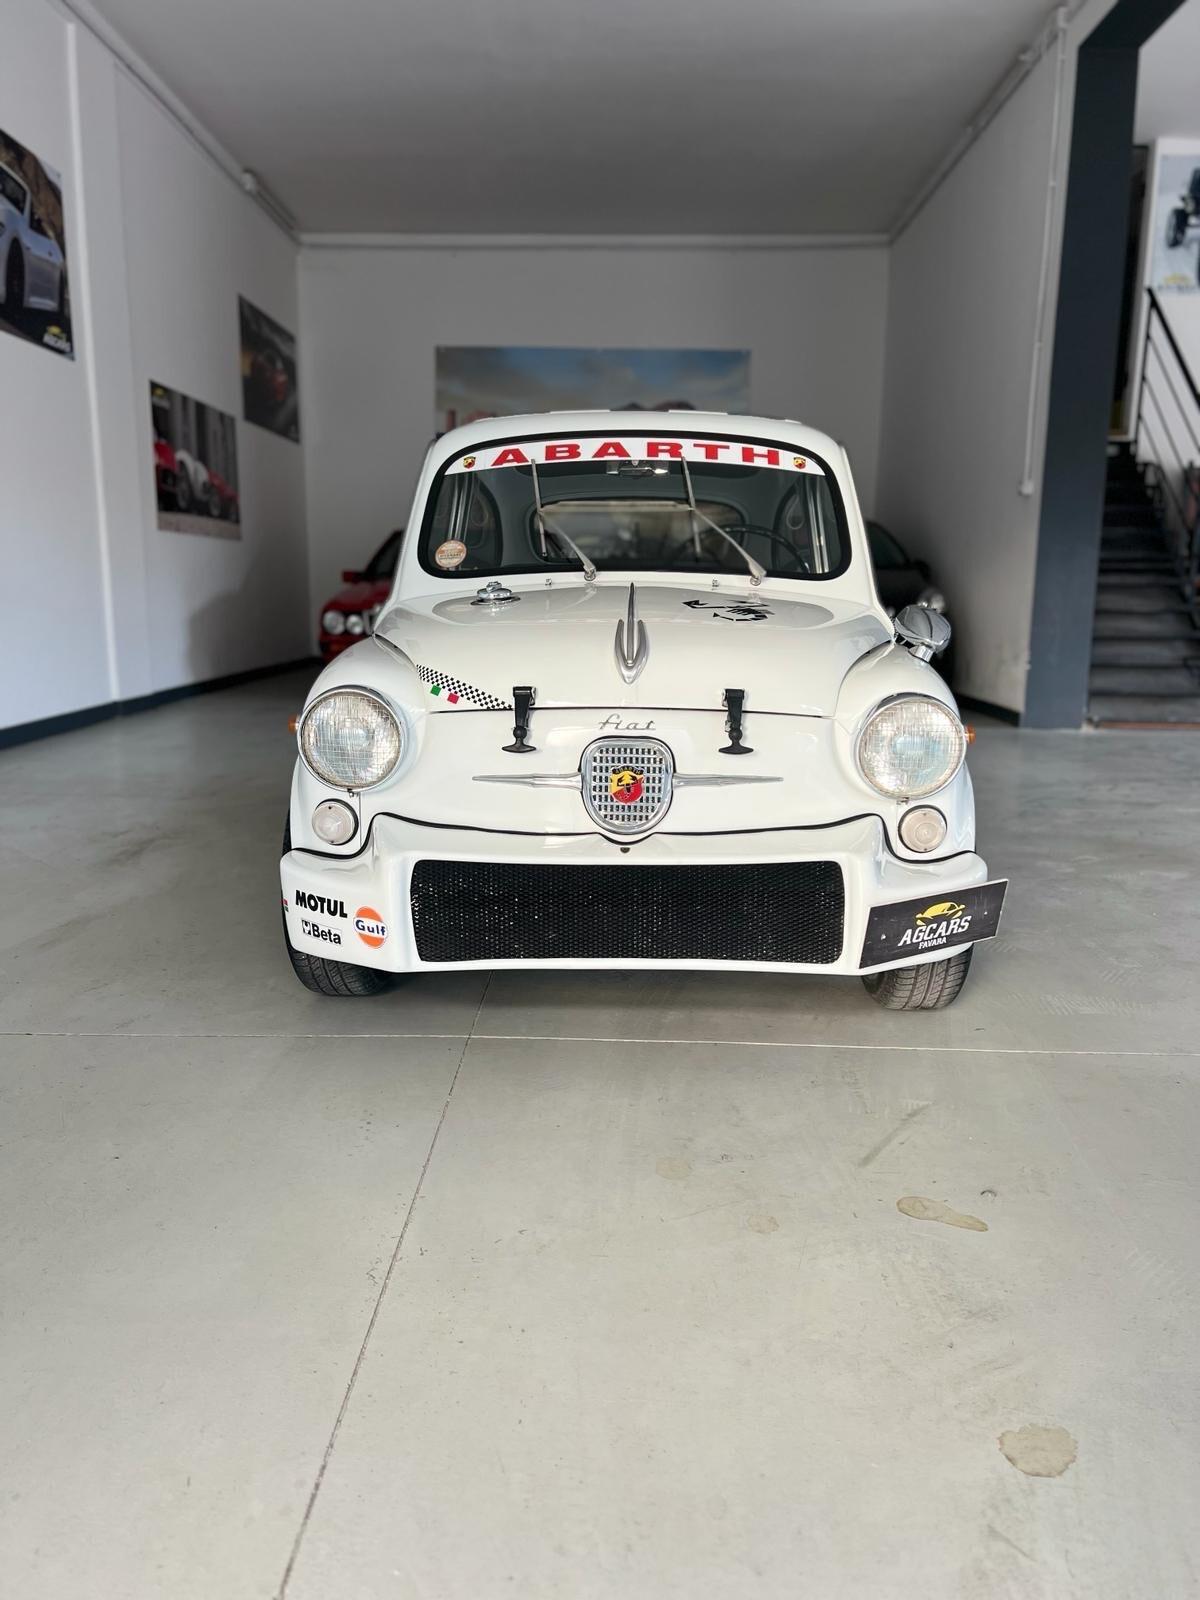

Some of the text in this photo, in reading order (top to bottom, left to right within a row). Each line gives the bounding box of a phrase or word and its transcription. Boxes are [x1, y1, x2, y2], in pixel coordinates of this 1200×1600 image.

[491, 441, 779, 467] ABARTH
[296, 890, 348, 918] MOTUL
[311, 922, 342, 945] Beta
[355, 919, 386, 936] Gulf
[897, 916, 972, 947] AGCARS
[918, 936, 947, 950] FAVARA
